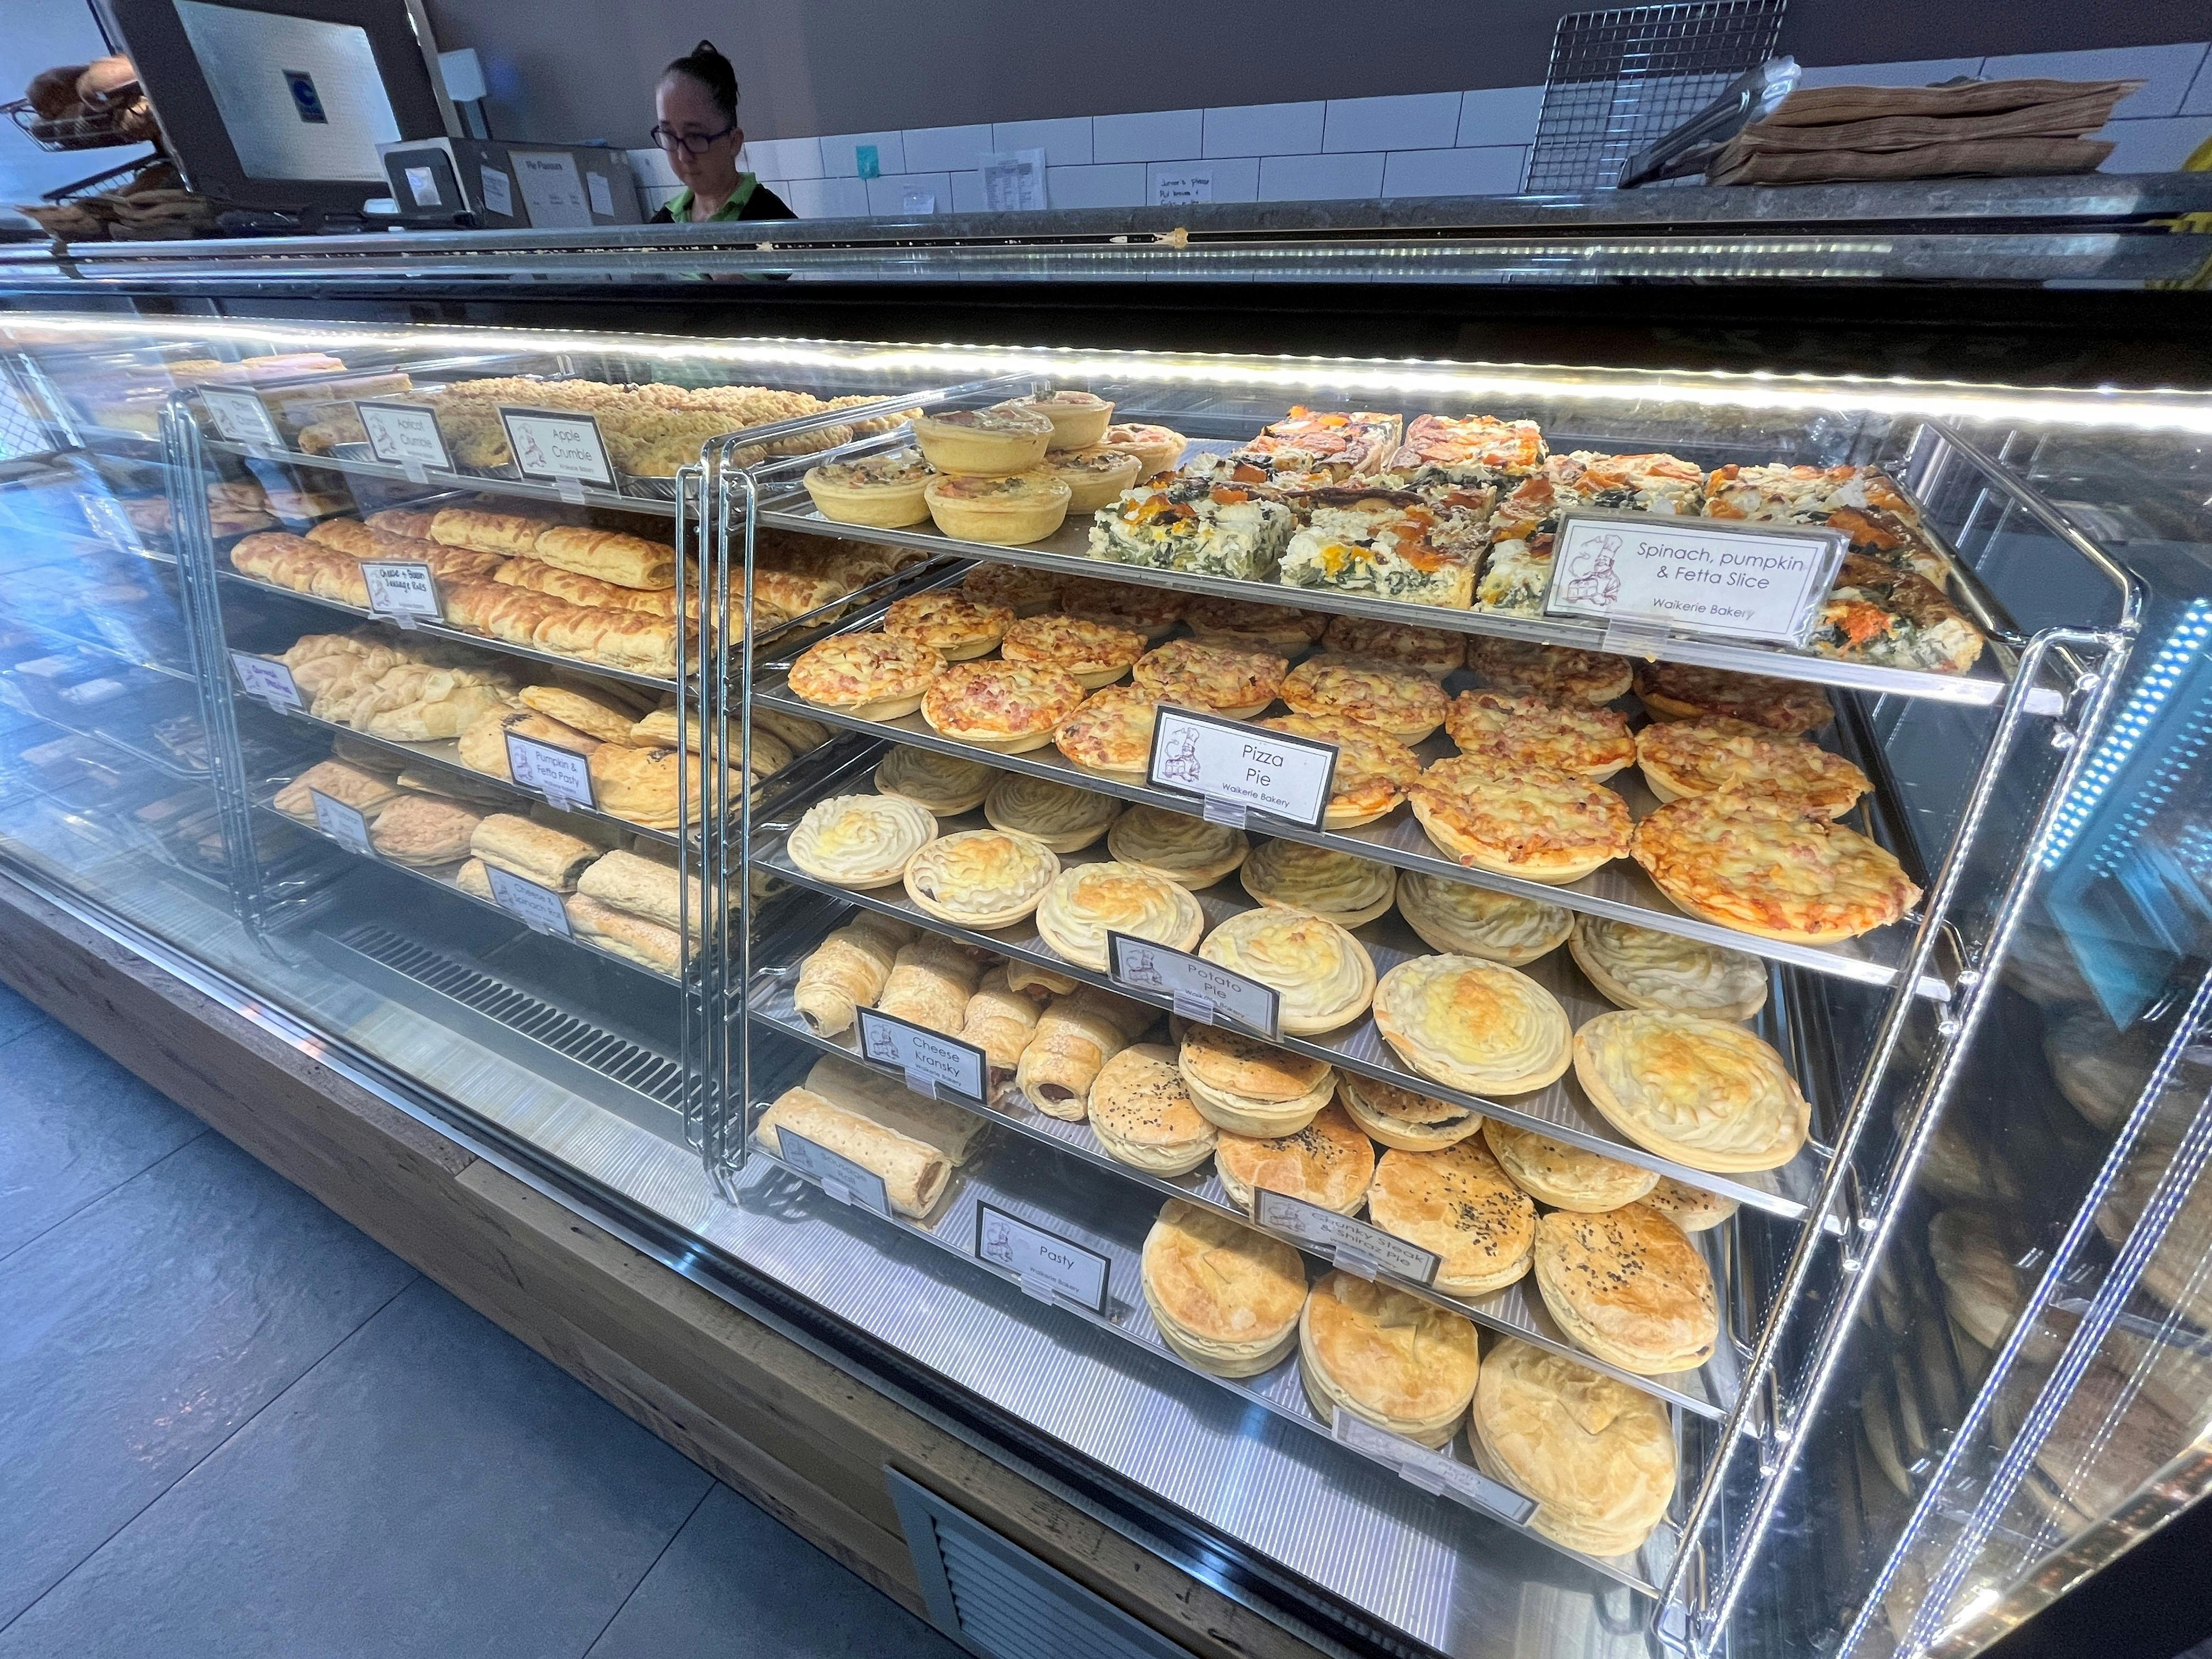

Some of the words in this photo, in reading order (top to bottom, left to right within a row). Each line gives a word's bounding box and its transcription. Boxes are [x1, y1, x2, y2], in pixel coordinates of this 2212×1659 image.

[397, 417, 425, 431] Apricot
[553, 428, 581, 443] Apple
[400, 433, 432, 449] Crumble
[552, 445, 592, 461] Crumble
[1637, 541, 1714, 563] Spinach,
[1720, 551, 1804, 573] pumpkin
[1656, 566, 1668, 579] &
[1675, 566, 1721, 584] Fetta
[1726, 571, 1770, 590] Slice
[1653, 597, 1707, 614] Waikerie
[1710, 604, 1756, 621] Bakery
[535, 751, 569, 770] Pumpkin
[571, 763, 577, 773] &
[1242, 744, 1284, 768] Pizza
[537, 764, 557, 779] Fetta
[558, 771, 579, 788] Pasty
[1246, 768, 1272, 787] Pie
[1222, 782, 1259, 799] Waikerie
[1260, 793, 1290, 808] Bakery
[1187, 964, 1242, 993] Potato
[1204, 983, 1227, 1000] Pie
[912, 1036, 960, 1063] Cheese
[915, 1050, 960, 1077] Kransky
[1312, 1212, 1373, 1240] Chunky
[1320, 1224, 1332, 1233] &
[1337, 1229, 1383, 1254] Shiraz
[1386, 1251, 1411, 1267] Pie
[1040, 1246, 1075, 1270] Pasty
